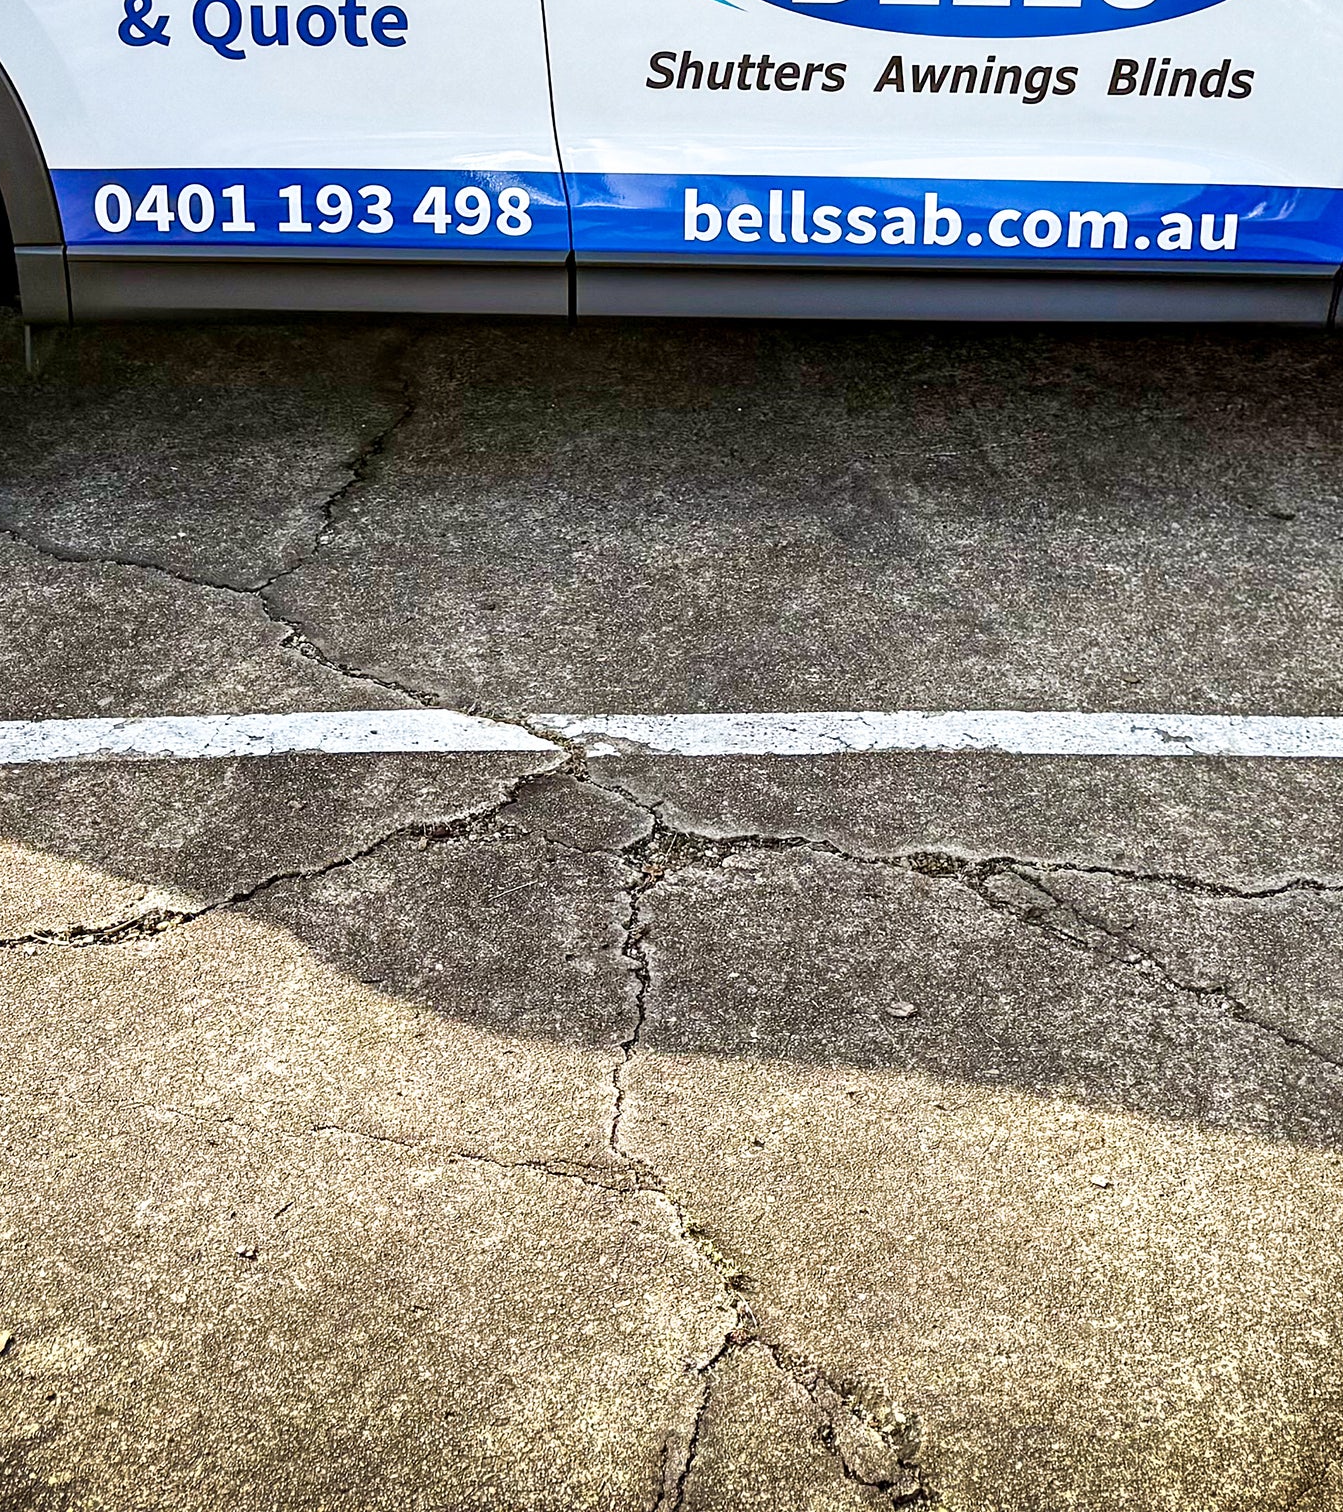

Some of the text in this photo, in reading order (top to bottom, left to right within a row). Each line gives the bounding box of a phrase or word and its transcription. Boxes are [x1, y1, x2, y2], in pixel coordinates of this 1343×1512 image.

[645, 50, 1255, 105] Shutters Awnings Blinds
[94, 183, 534, 237] 0401 193 498
[683, 187, 1239, 251] bellssab.com.au
